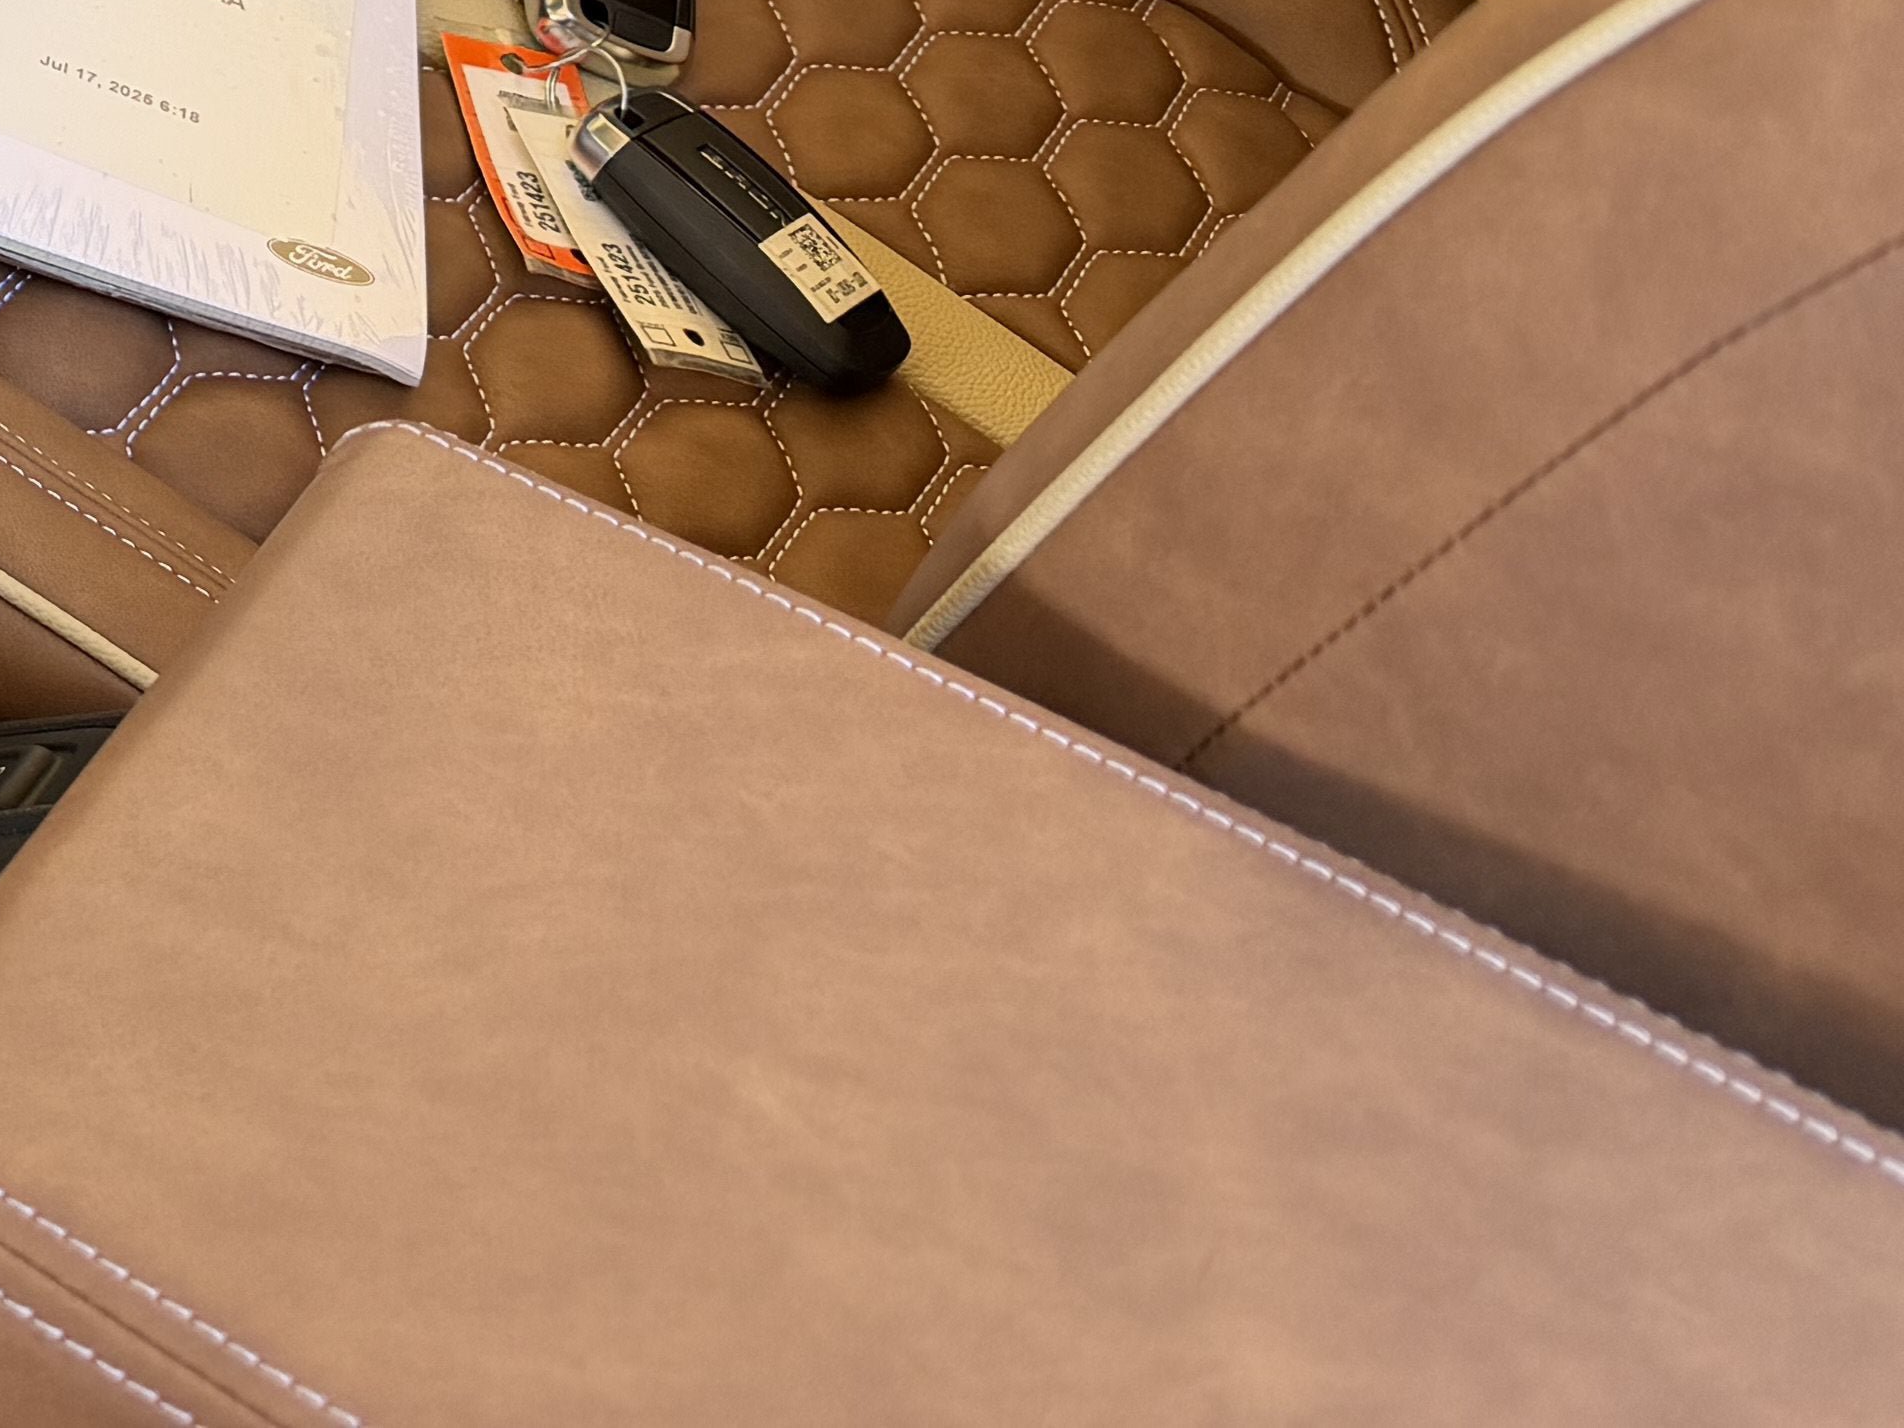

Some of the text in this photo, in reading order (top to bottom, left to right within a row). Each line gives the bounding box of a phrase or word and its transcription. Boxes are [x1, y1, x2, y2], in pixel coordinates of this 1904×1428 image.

[40, 56, 68, 75] Jul
[76, 67, 102, 88] 17,
[159, 100, 200, 124] 6:18
[516, 171, 561, 234] 251423
[601, 243, 656, 307] 251423
